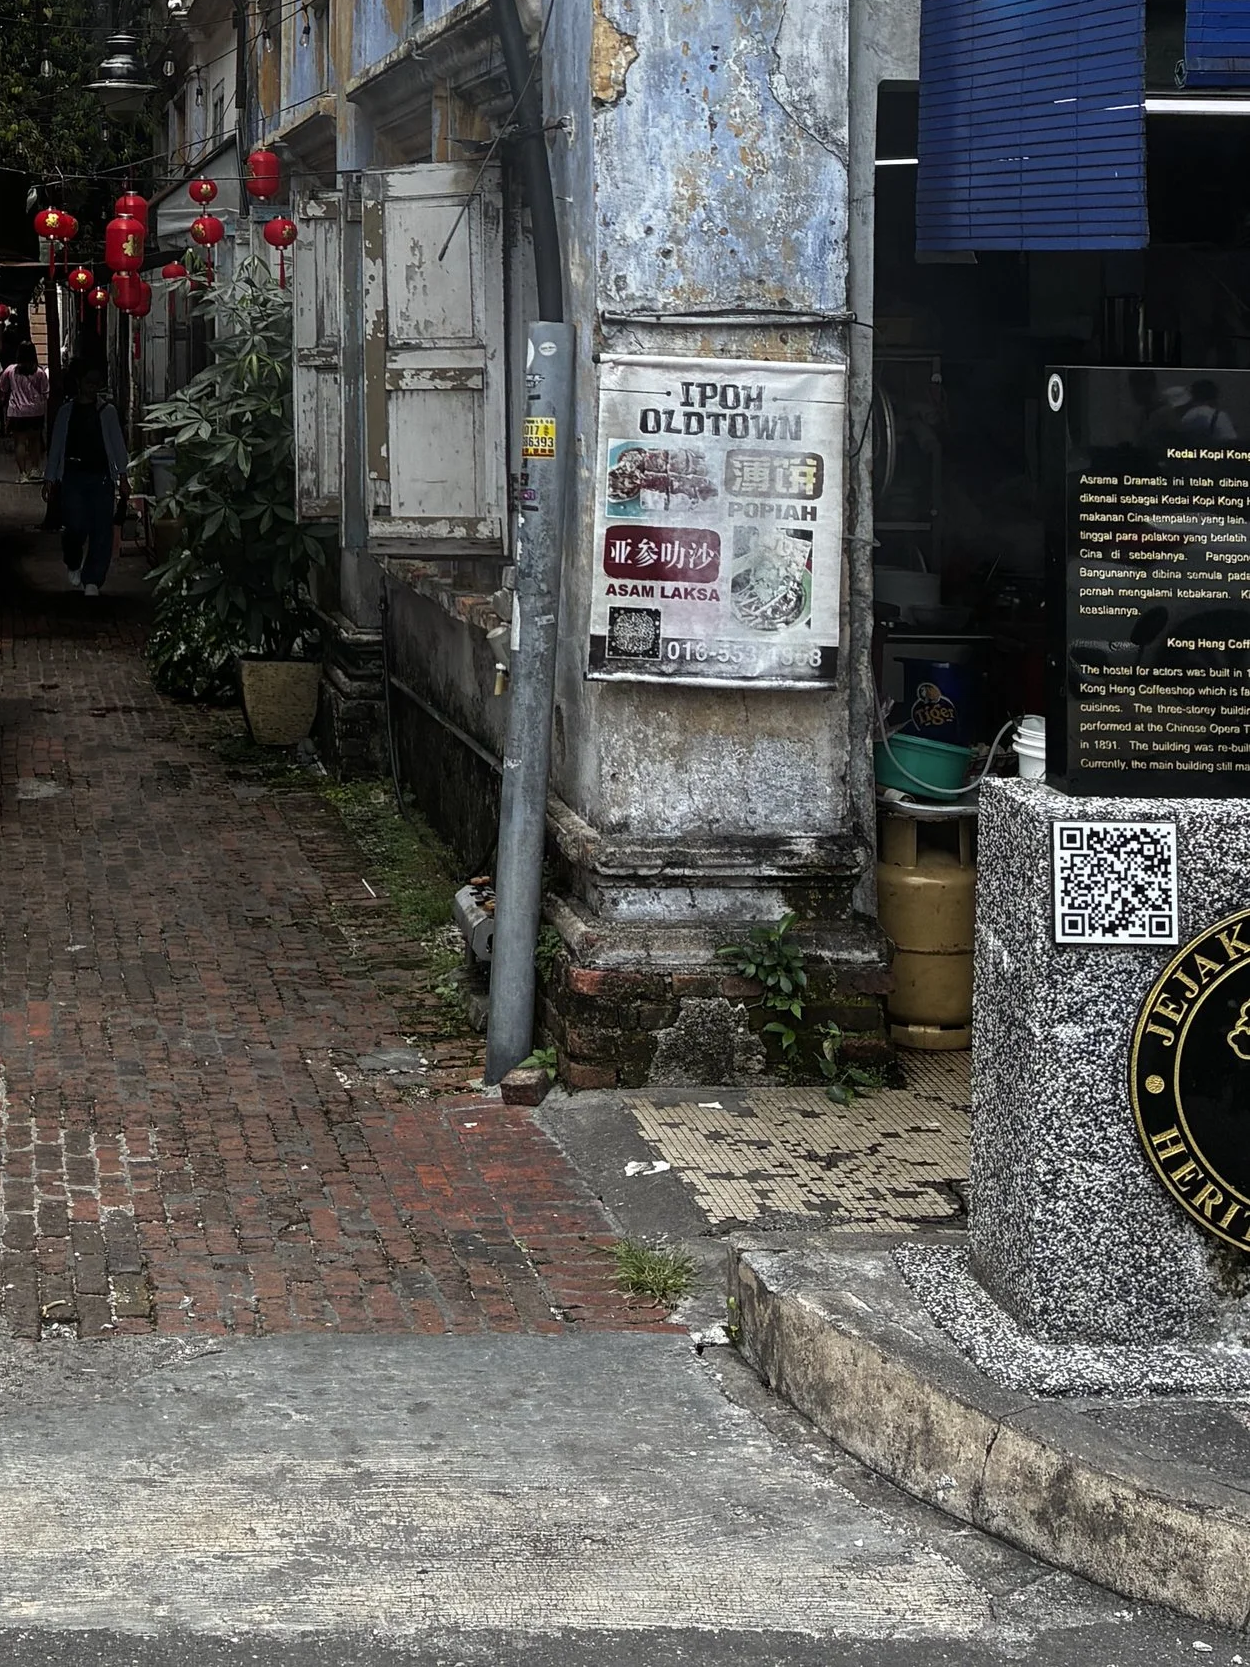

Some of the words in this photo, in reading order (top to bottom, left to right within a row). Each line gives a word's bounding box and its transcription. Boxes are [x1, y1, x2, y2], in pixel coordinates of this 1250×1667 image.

[680, 381, 766, 411] IPOH
[639, 408, 801, 440] OLDTOWN
[1167, 449, 1197, 458] Kedai
[1200, 449, 1224, 461] Kopi
[1080, 475, 1118, 485] Asrama
[1124, 475, 1167, 486] Dramatis
[1173, 477, 1184, 486] ini
[1190, 477, 1213, 486] telah
[1219, 478, 1248, 487] dibina
[1080, 493, 1117, 503] dikenali
[1120, 494, 1158, 506] sebagai
[1162, 495, 1189, 504] Kedai
[1193, 496, 1214, 507] Kopi
[1218, 496, 1243, 508] Kong
[728, 502, 817, 521] POPIAH
[1080, 512, 1124, 522] makanan
[1127, 513, 1150, 522] Cina
[1201, 516, 1224, 526] yang
[1080, 531, 1112, 542] tinggal
[1116, 533, 1138, 542] para
[1183, 535, 1207, 544] yang
[609, 539, 715, 570] 亚参叻沙
[1080, 549, 1102, 559] Cina
[1111, 550, 1120, 559] di
[1129, 550, 1188, 562] sebelahnya.
[1080, 568, 1146, 580] Bangunannya
[1152, 569, 1181, 579] dibina
[1187, 570, 1222, 580] semula
[606, 584, 654, 598] ASAM
[660, 586, 720, 601] LAKSA
[1080, 588, 1113, 597] pernah
[1118, 588, 1172, 599] mengalami
[1177, 589, 1231, 598] kebakaran.
[1080, 605, 1141, 617] keasliannya.
[1167, 638, 1195, 650] Kong
[1198, 638, 1225, 650] Heng
[1080, 665, 1099, 674] The
[1103, 666, 1132, 675] hostel
[1136, 666, 1149, 675] for
[1153, 668, 1183, 676] actors
[1186, 669, 1206, 677] was
[1210, 668, 1230, 677] built
[1234, 668, 1242, 677] in
[1080, 684, 1105, 695] Kong
[1109, 685, 1135, 696] Heng
[1139, 685, 1195, 697] Coffeeshop
[1198, 686, 1226, 696] which
[1230, 687, 1238, 696] is
[916, 703, 955, 726] Tiger
[1080, 703, 1122, 712] cuisines.
[1134, 703, 1152, 713] The
[1158, 704, 1216, 716] three-storey
[1080, 721, 1131, 732] performed
[1135, 722, 1144, 731] at
[1148, 722, 1163, 732] the
[1166, 723, 1206, 732] Chinese
[1210, 724, 1240, 735] Opera
[1080, 740, 1089, 749] in
[1094, 740, 1120, 750] 1891.
[1129, 740, 1148, 750] The
[1152, 741, 1190, 753] building
[1080, 759, 1128, 770] Currently,
[1132, 760, 1146, 769] the
[1150, 761, 1173, 770] main
[1176, 761, 1213, 773] building
[1217, 762, 1232, 770] still
